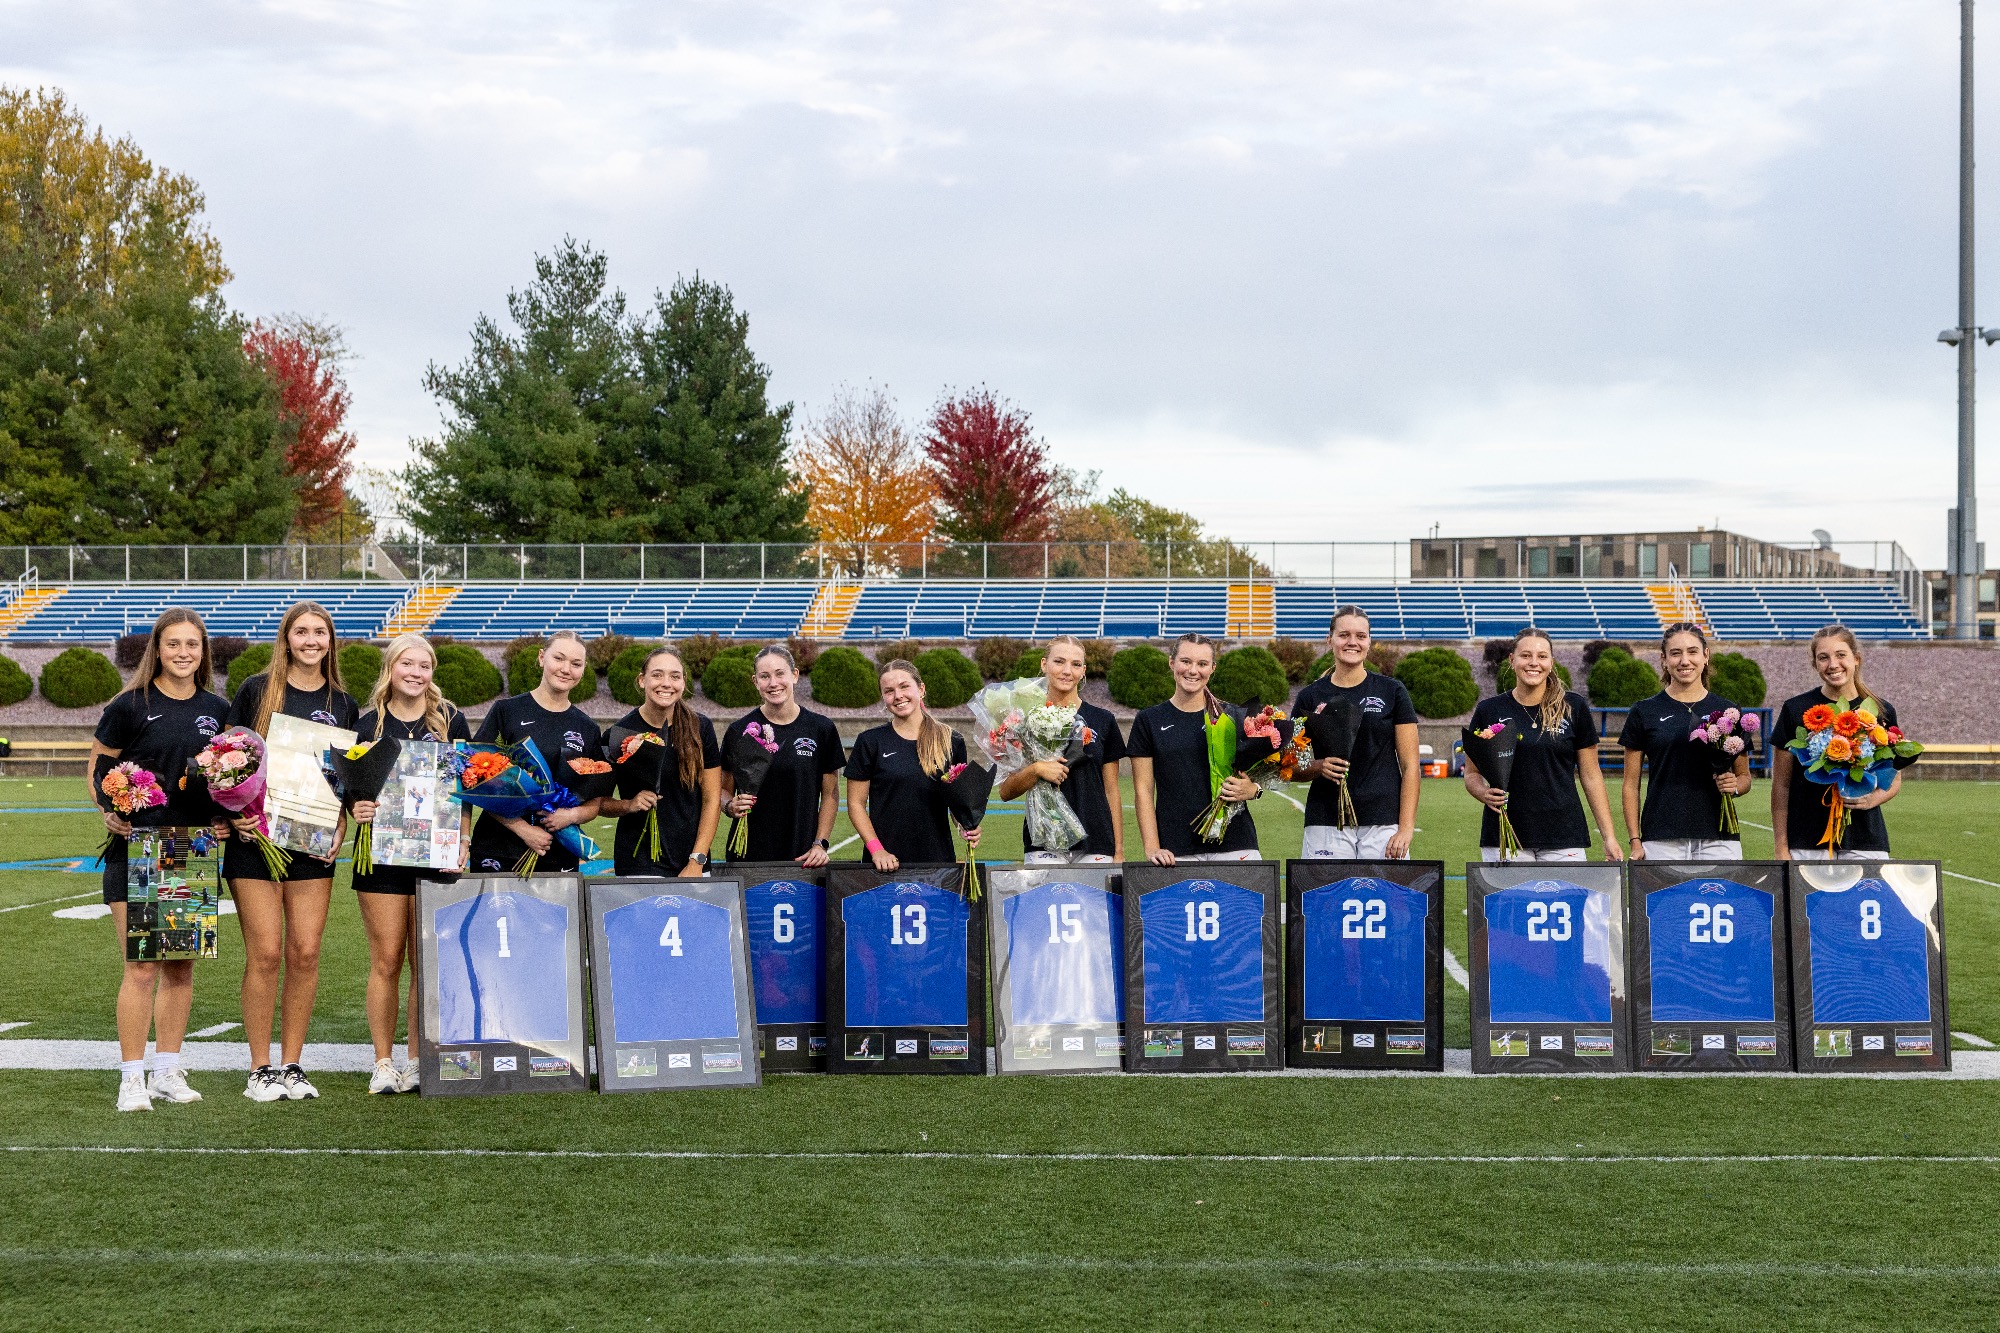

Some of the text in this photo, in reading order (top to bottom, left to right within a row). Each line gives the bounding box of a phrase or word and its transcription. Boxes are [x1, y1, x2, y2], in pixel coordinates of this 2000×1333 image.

[497, 917, 511, 957] 1
[659, 916, 683, 956] 4
[773, 903, 794, 943] 6
[890, 904, 927, 945] 13
[1047, 903, 1082, 944] 15
[1184, 901, 1220, 942] 18
[1342, 899, 1386, 939] 22
[1526, 901, 1572, 942] 23
[1689, 903, 1734, 944] 26
[1860, 899, 1882, 940] 8
